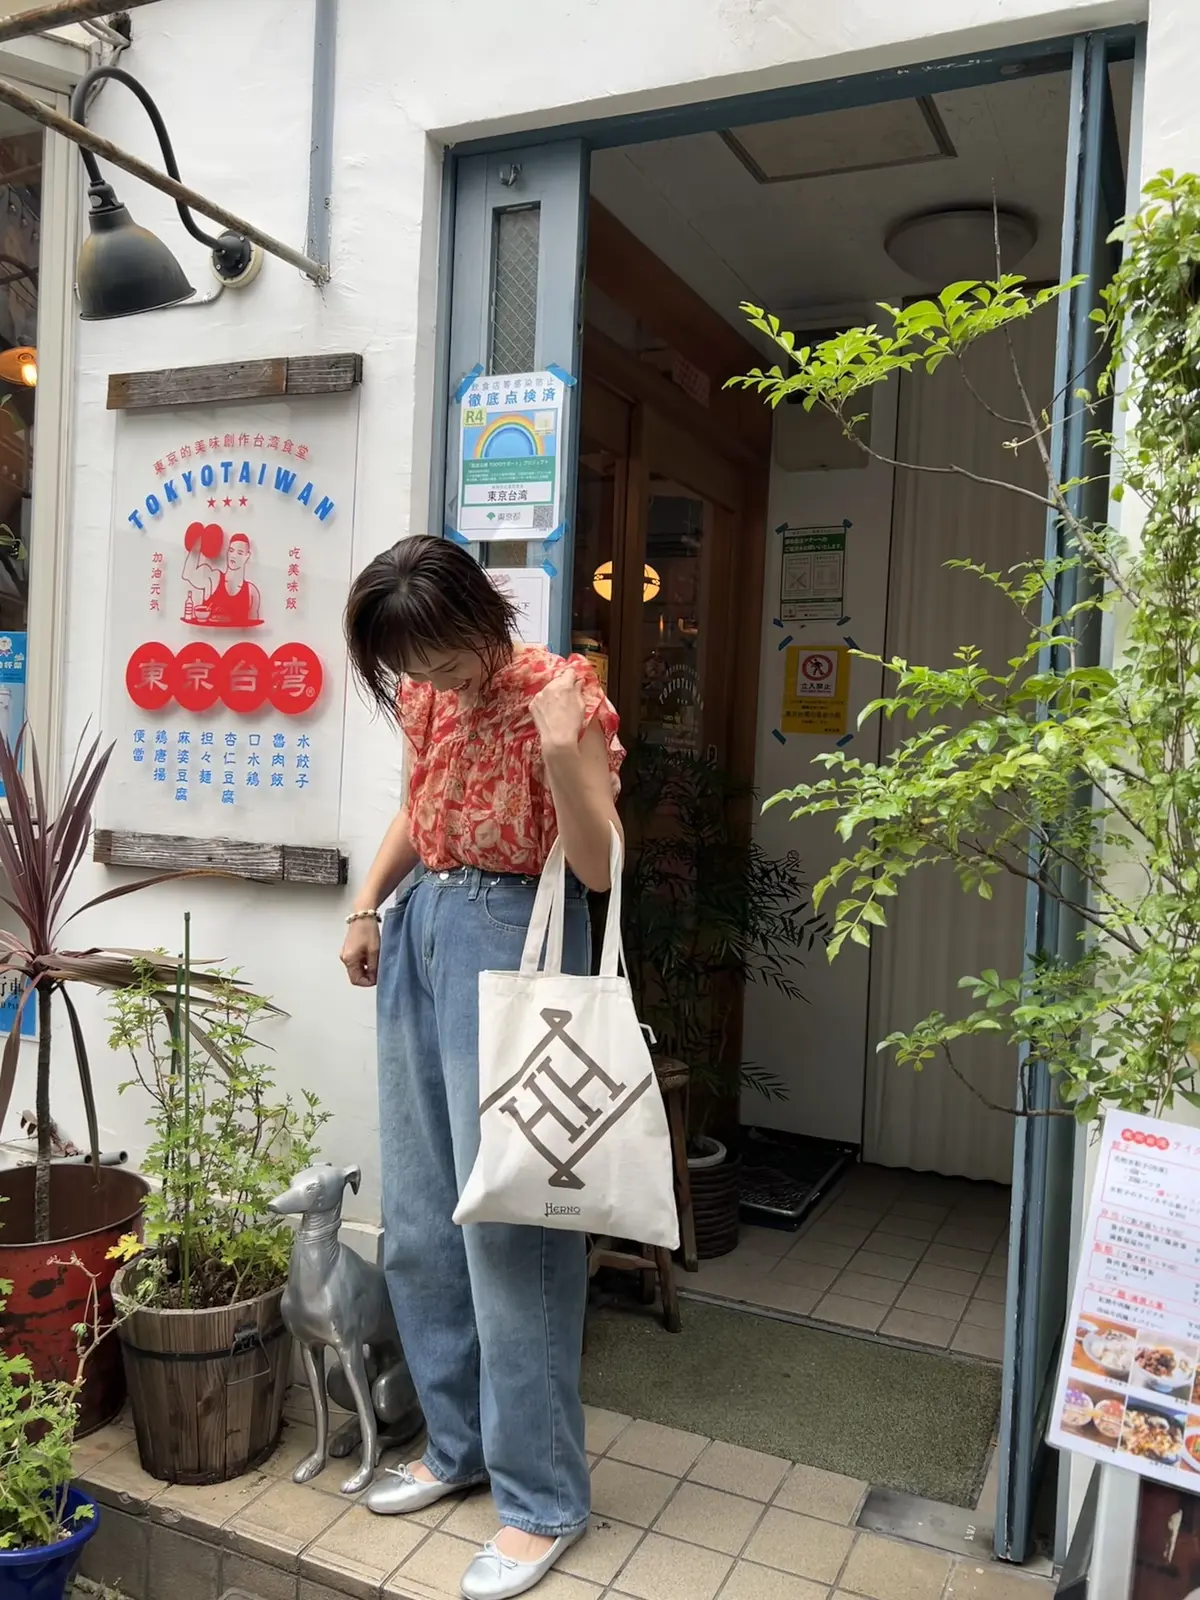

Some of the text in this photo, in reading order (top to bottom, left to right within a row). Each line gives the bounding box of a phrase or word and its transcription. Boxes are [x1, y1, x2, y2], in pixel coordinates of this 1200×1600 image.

[468, 387, 556, 407] 徹底点検済
[465, 410, 484, 423] R4
[128, 461, 335, 530] TOKYOTAIWAN
[487, 489, 528, 502] 東京台湾
[134, 656, 307, 697] 東京台湾
[295, 735, 310, 788] 水餃子
